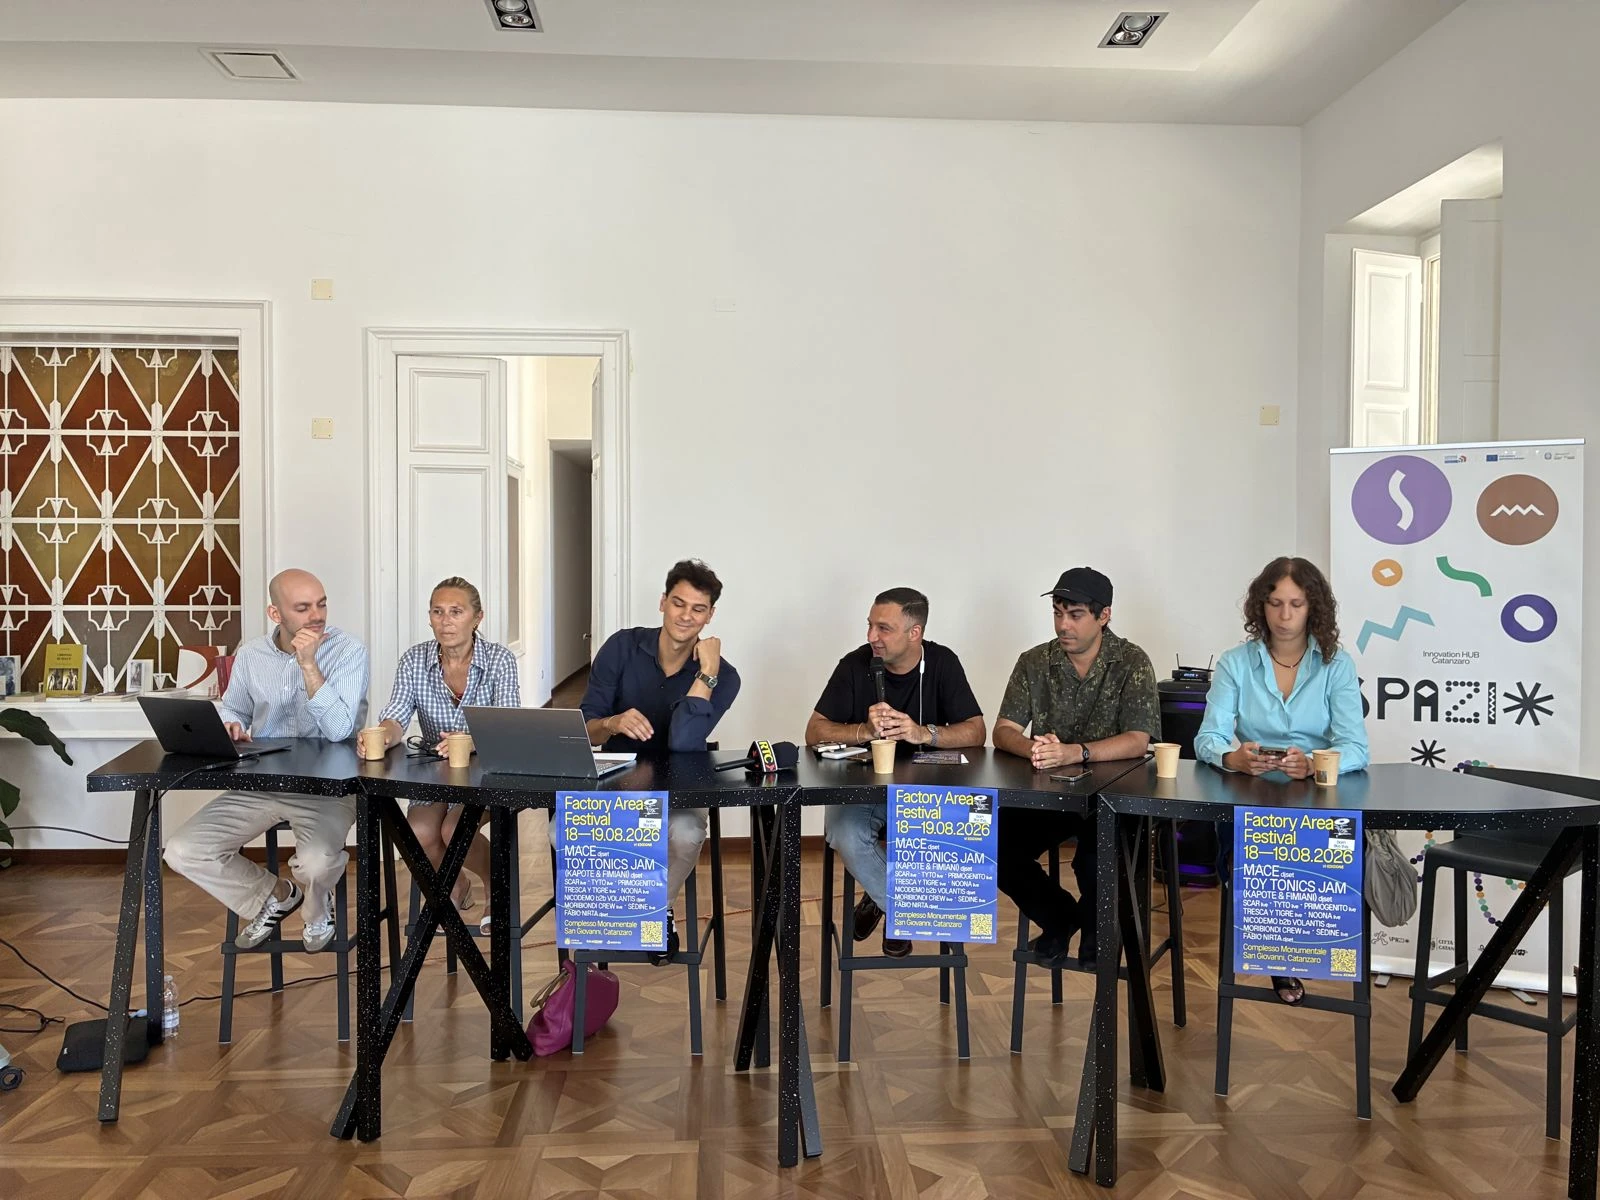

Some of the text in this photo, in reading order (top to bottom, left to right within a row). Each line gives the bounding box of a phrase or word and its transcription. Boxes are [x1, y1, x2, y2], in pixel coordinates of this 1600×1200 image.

[758, 741, 774, 764] RTC
[565, 796, 612, 812] Factory
[614, 797, 644, 811] Area
[896, 790, 974, 807] Factory Area
[896, 805, 941, 819] Festival
[566, 812, 610, 826] Festival
[1244, 812, 1297, 831] Factory
[1300, 815, 1334, 830] Area
[1244, 829, 1296, 845] Festival
[895, 838, 927, 849] MACE
[565, 846, 596, 856] MACE
[895, 850, 984, 864] TOY TONICS JAM
[1244, 845, 1353, 864] 18—19.08.2026
[565, 858, 654, 870] TOY TONICS JAM
[895, 862, 924, 870] (KAPOTE
[1244, 864, 1279, 877] MACE
[1244, 877, 1346, 894] TOY TONICS JAM
[1244, 890, 1276, 900] (KAPOTE
[1286, 893, 1317, 902] FIMIANI)
[1304, 903, 1348, 912] PRIMOGENITO
[895, 911, 967, 920] Complesso Monumentale
[1243, 916, 1278, 925] NICODEMO
[1292, 919, 1325, 927] VOLANTIS
[565, 920, 596, 928] Complesso
[1243, 943, 1327, 955] Complesso Monumentale
[1257, 953, 1286, 962] Giovanni,
[1288, 955, 1321, 964] Catanzaro
